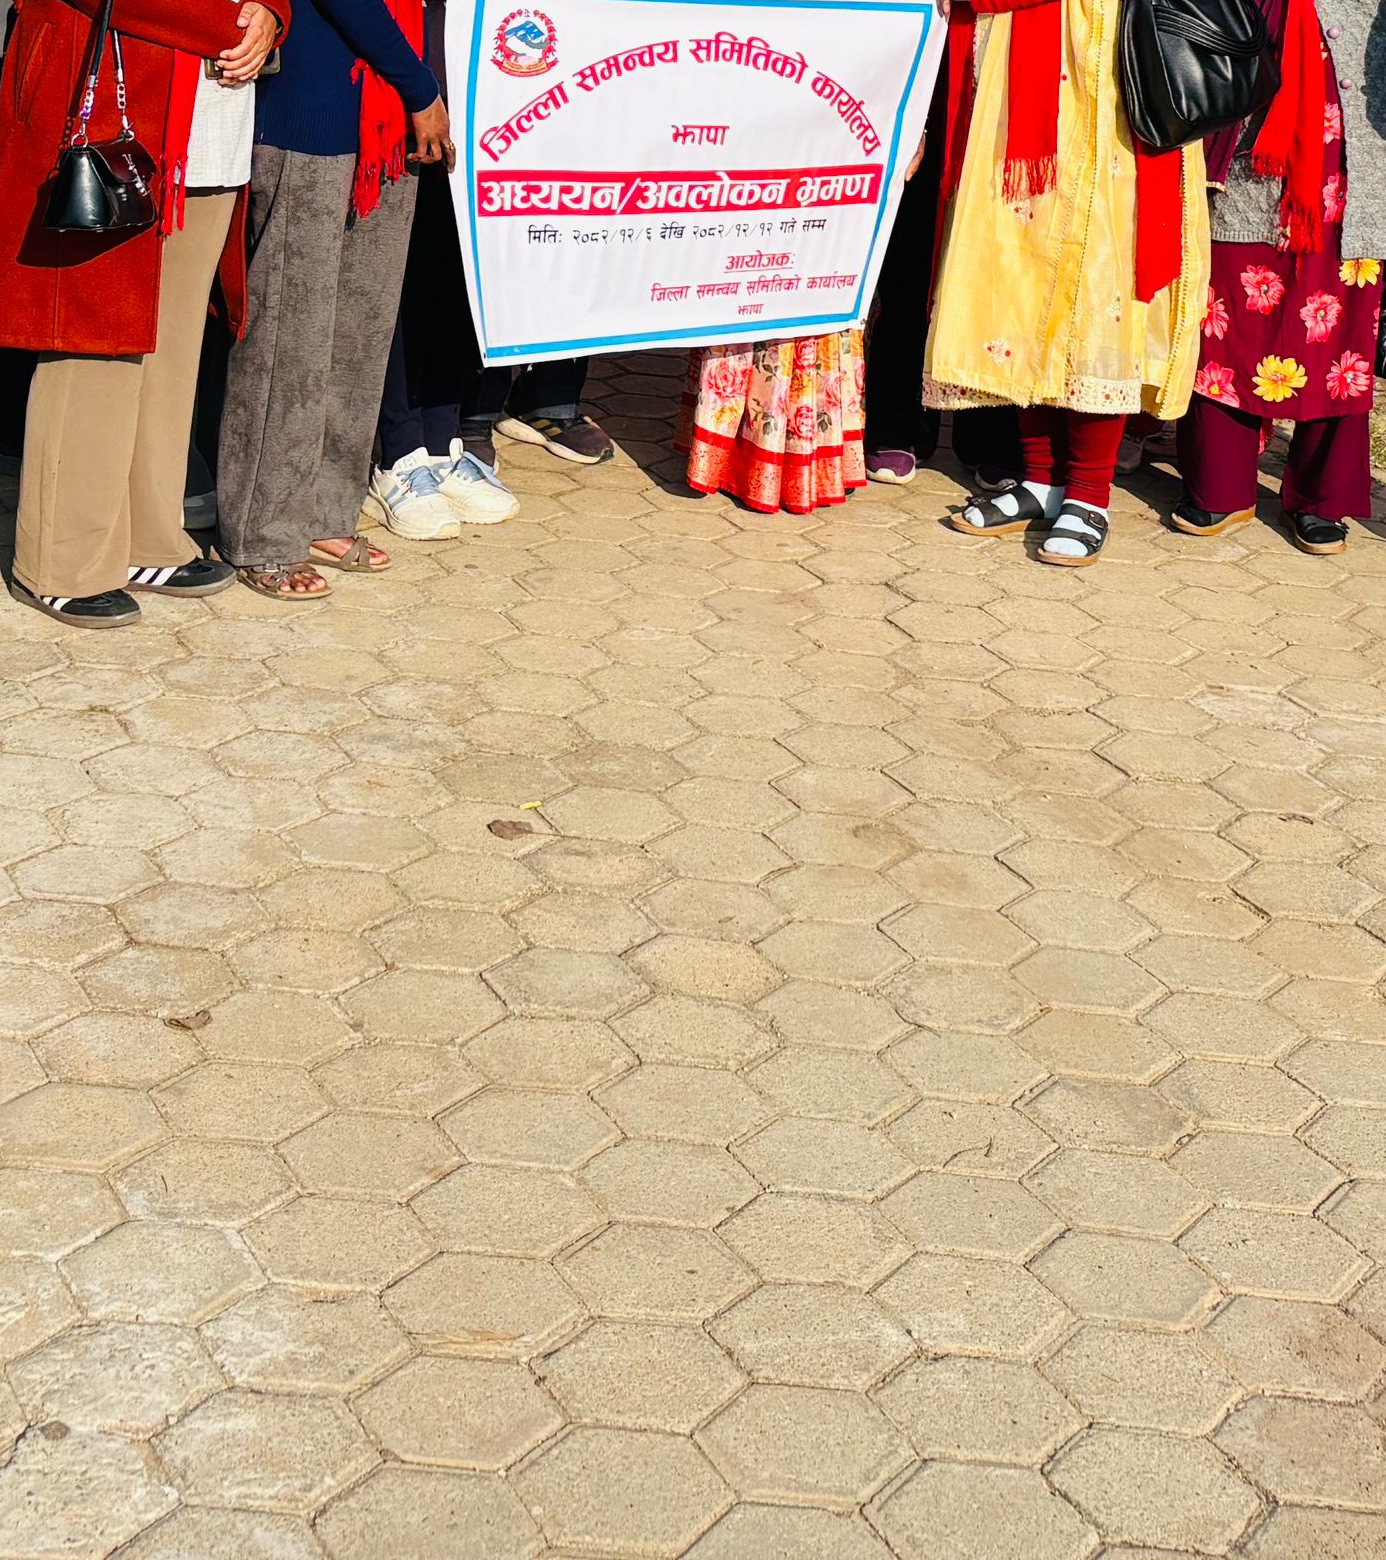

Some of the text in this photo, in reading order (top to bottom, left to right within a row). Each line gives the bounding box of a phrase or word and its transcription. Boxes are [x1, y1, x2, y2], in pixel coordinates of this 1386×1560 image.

[480, 31, 881, 162] जिल्ला समन्वय समितिको कार्यालय
[671, 124, 729, 146] झापा
[481, 170, 874, 214] अध्ययन/अवलोकन भ्रमण
[660, 221, 685, 240] देखि
[779, 218, 797, 234] गते
[802, 219, 827, 232] सम्म
[651, 271, 858, 302] जिल्ला समन्वय समितिको कार्यालय
[737, 303, 764, 315] झापा
